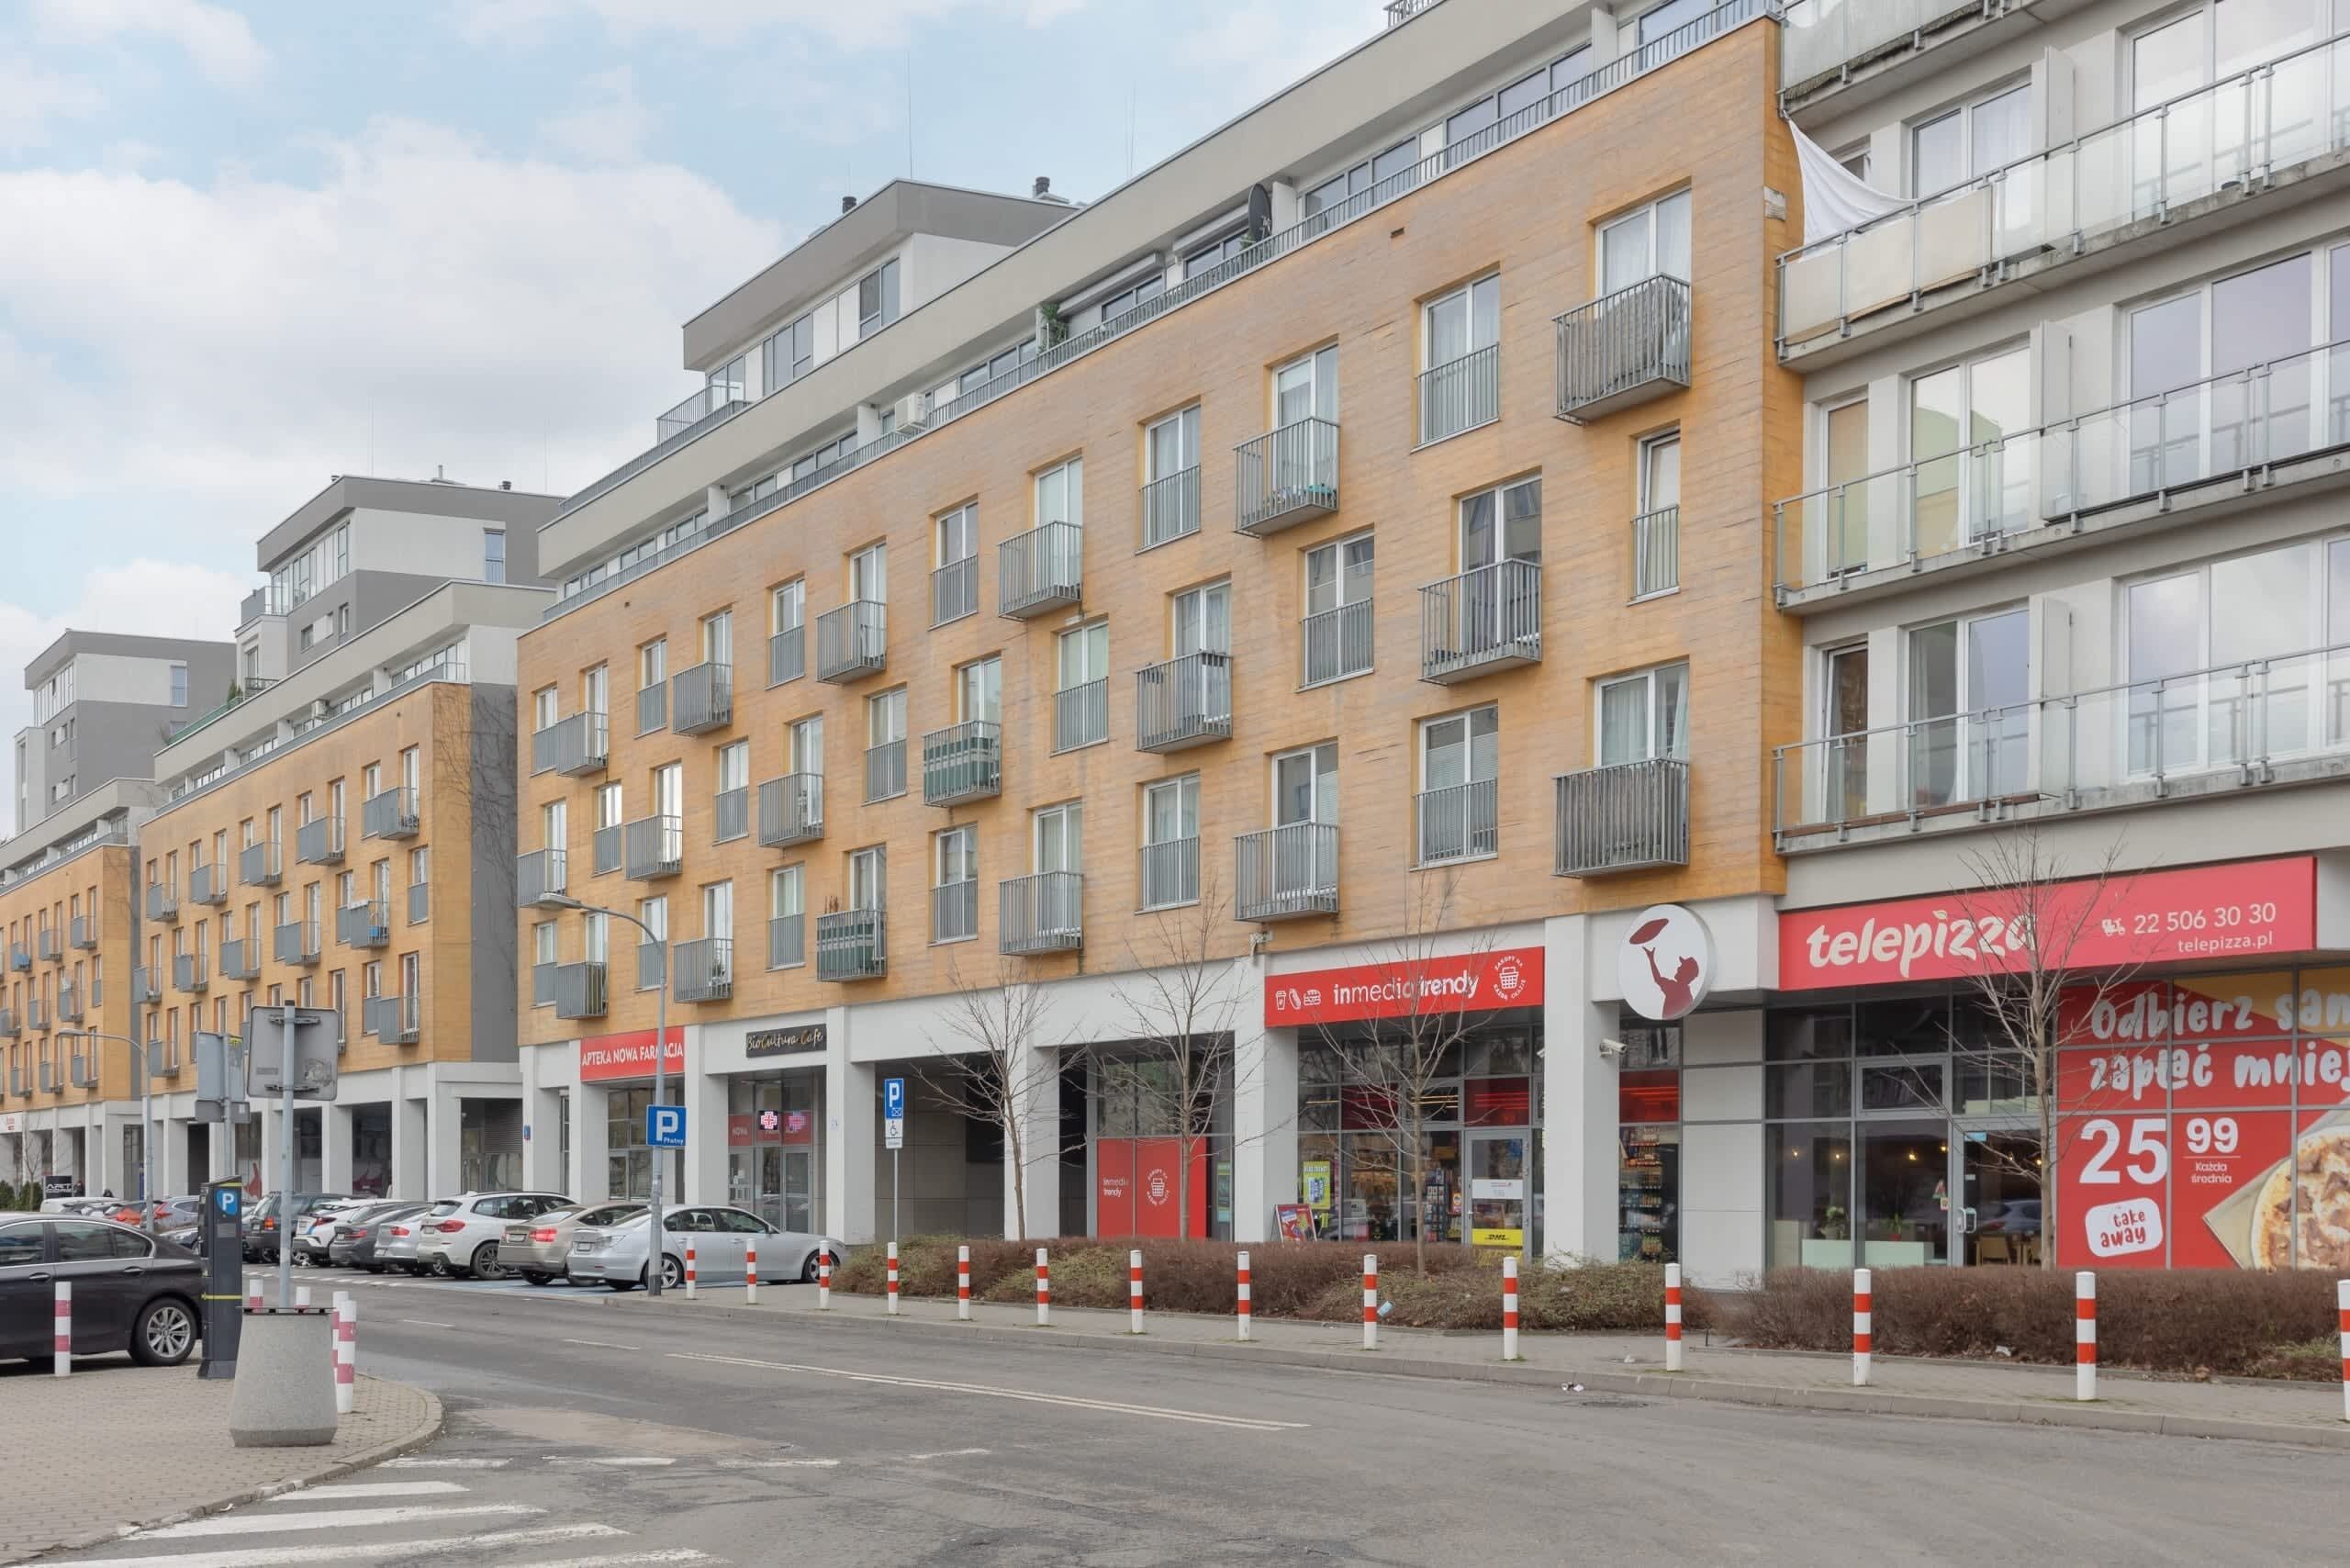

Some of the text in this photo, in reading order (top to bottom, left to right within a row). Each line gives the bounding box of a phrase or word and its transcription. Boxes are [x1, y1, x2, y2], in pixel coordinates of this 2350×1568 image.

[2133, 902, 2277, 935] 22 506 30 30
[1806, 910, 2035, 978] telepizza
[2177, 931, 2273, 953] telepizza.pl
[2091, 992, 2254, 1039] Odbierz
[582, 1050, 611, 1066] APTEKA
[613, 1045, 638, 1063] NOWA
[2089, 1044, 2213, 1101] zapłać
[889, 1082, 900, 1107] P
[655, 1111, 678, 1141] P
[2079, 1117, 2238, 1184] 25 99
[222, 1193, 234, 1211] P
[2113, 1209, 2145, 1227] take
[2100, 1226, 2146, 1249] away
